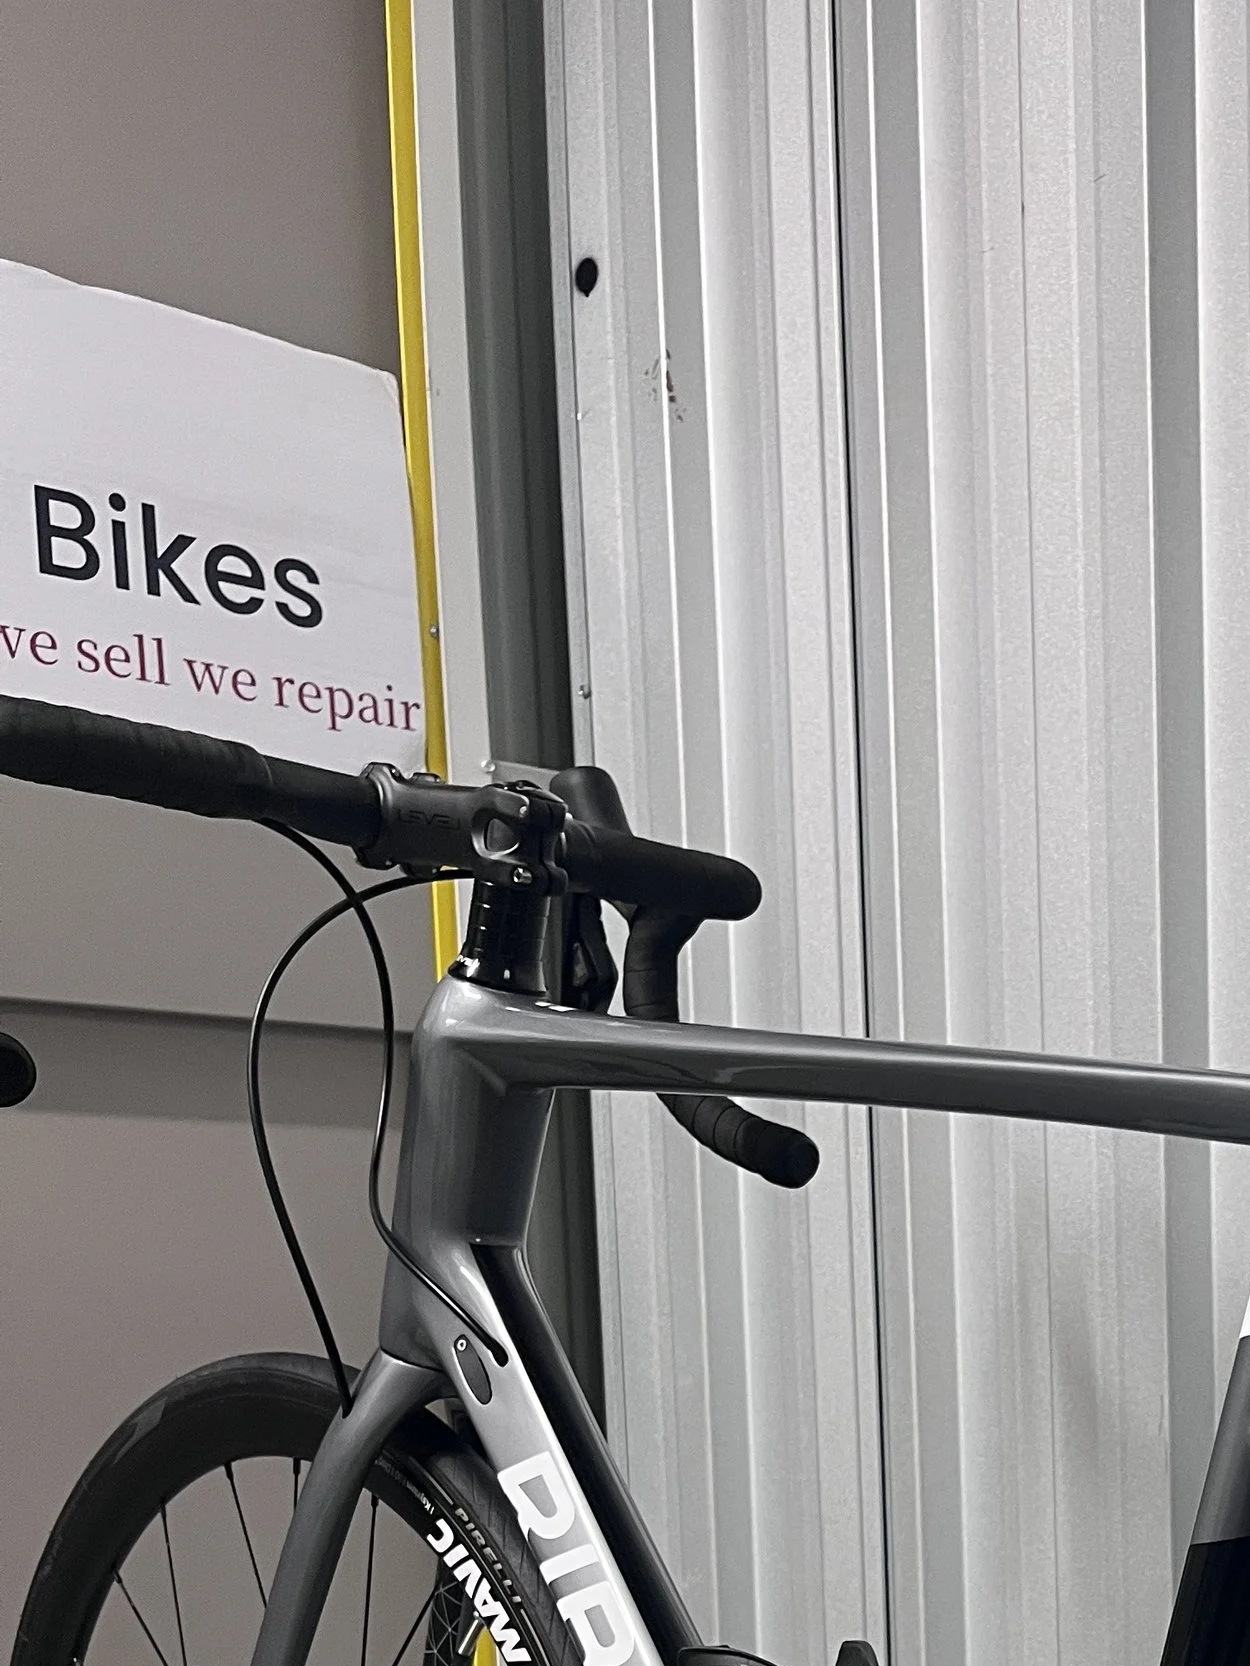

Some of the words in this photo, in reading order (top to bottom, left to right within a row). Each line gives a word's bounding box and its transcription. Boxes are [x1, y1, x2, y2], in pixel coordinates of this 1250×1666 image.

[34, 485, 324, 629] Bikes
[76, 633, 171, 687] sell
[184, 655, 257, 702] we
[273, 674, 421, 732] repair
[426, 1518, 532, 1663] MAVIC
